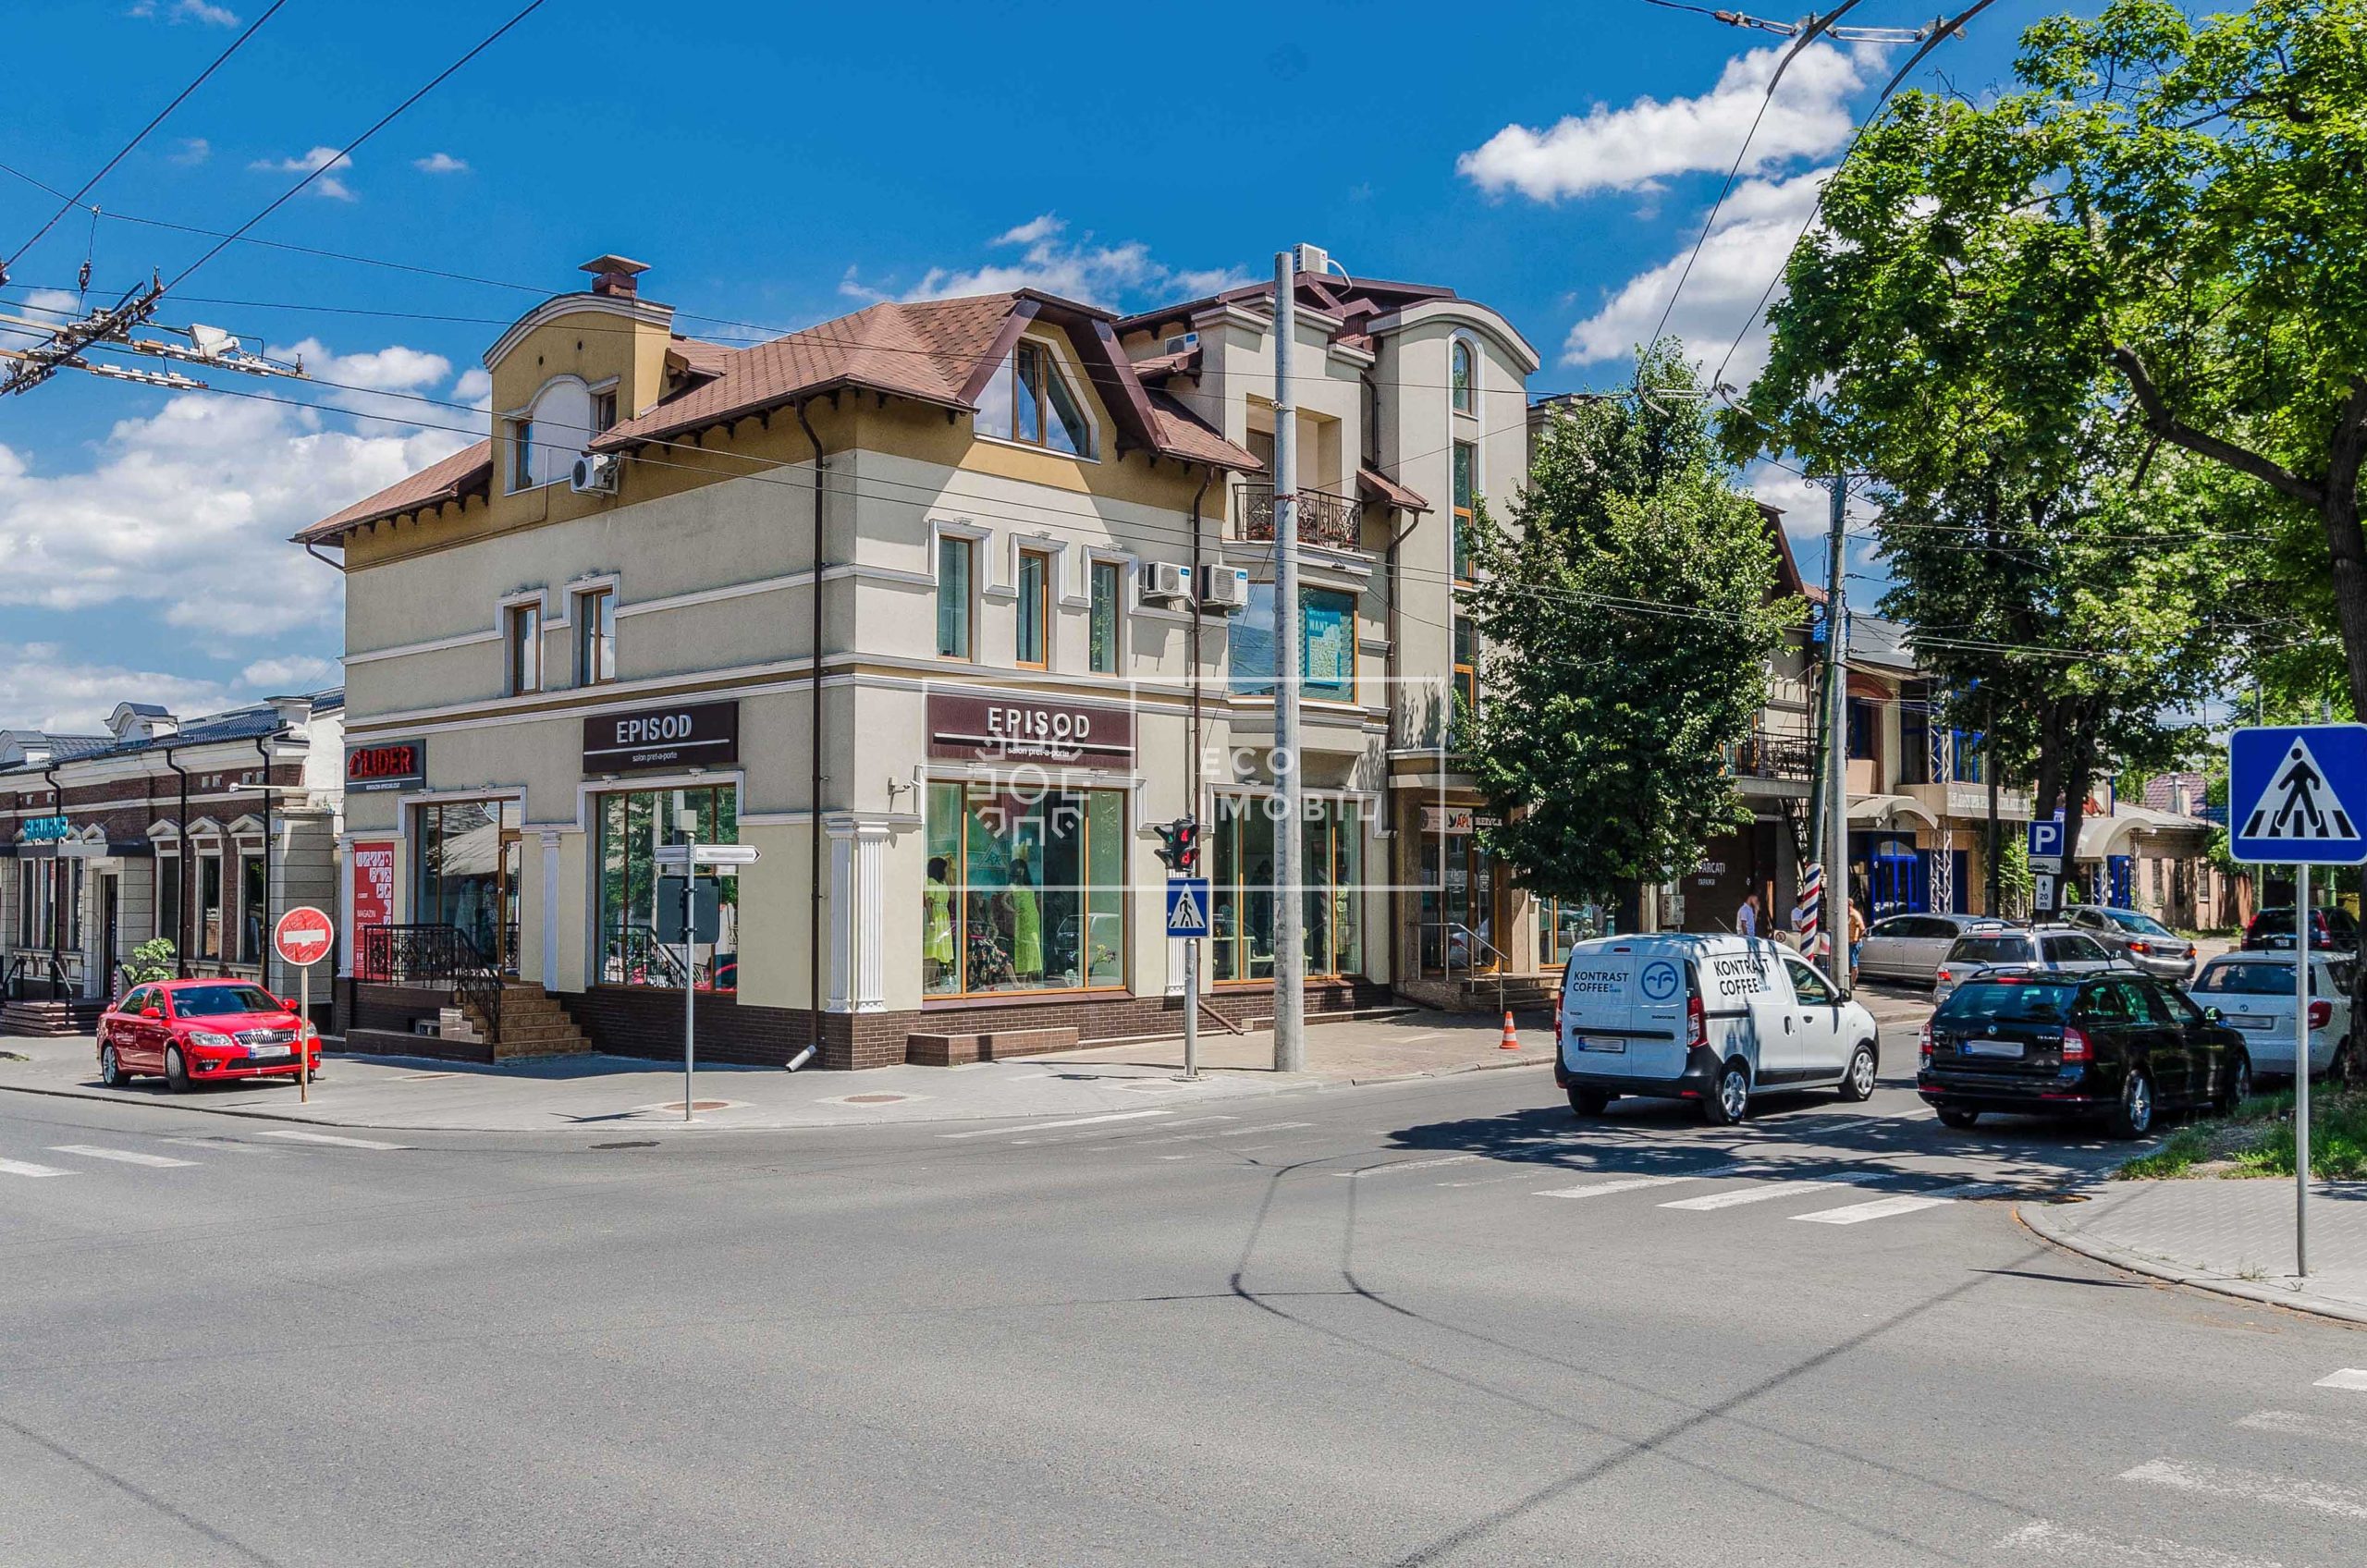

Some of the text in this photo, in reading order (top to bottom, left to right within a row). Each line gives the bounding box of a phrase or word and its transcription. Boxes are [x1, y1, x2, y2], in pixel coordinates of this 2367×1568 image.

[616, 714, 693, 743] EPISOD
[987, 706, 1090, 739] EPISOD
[1007, 746, 1027, 755] salon
[2035, 826, 2056, 852] P
[1713, 959, 1771, 976] KONTRAST
[1574, 971, 1629, 982] KONTRAST
[1573, 982, 1609, 993] COFFEE
[1719, 978, 1760, 996] COFFEE
